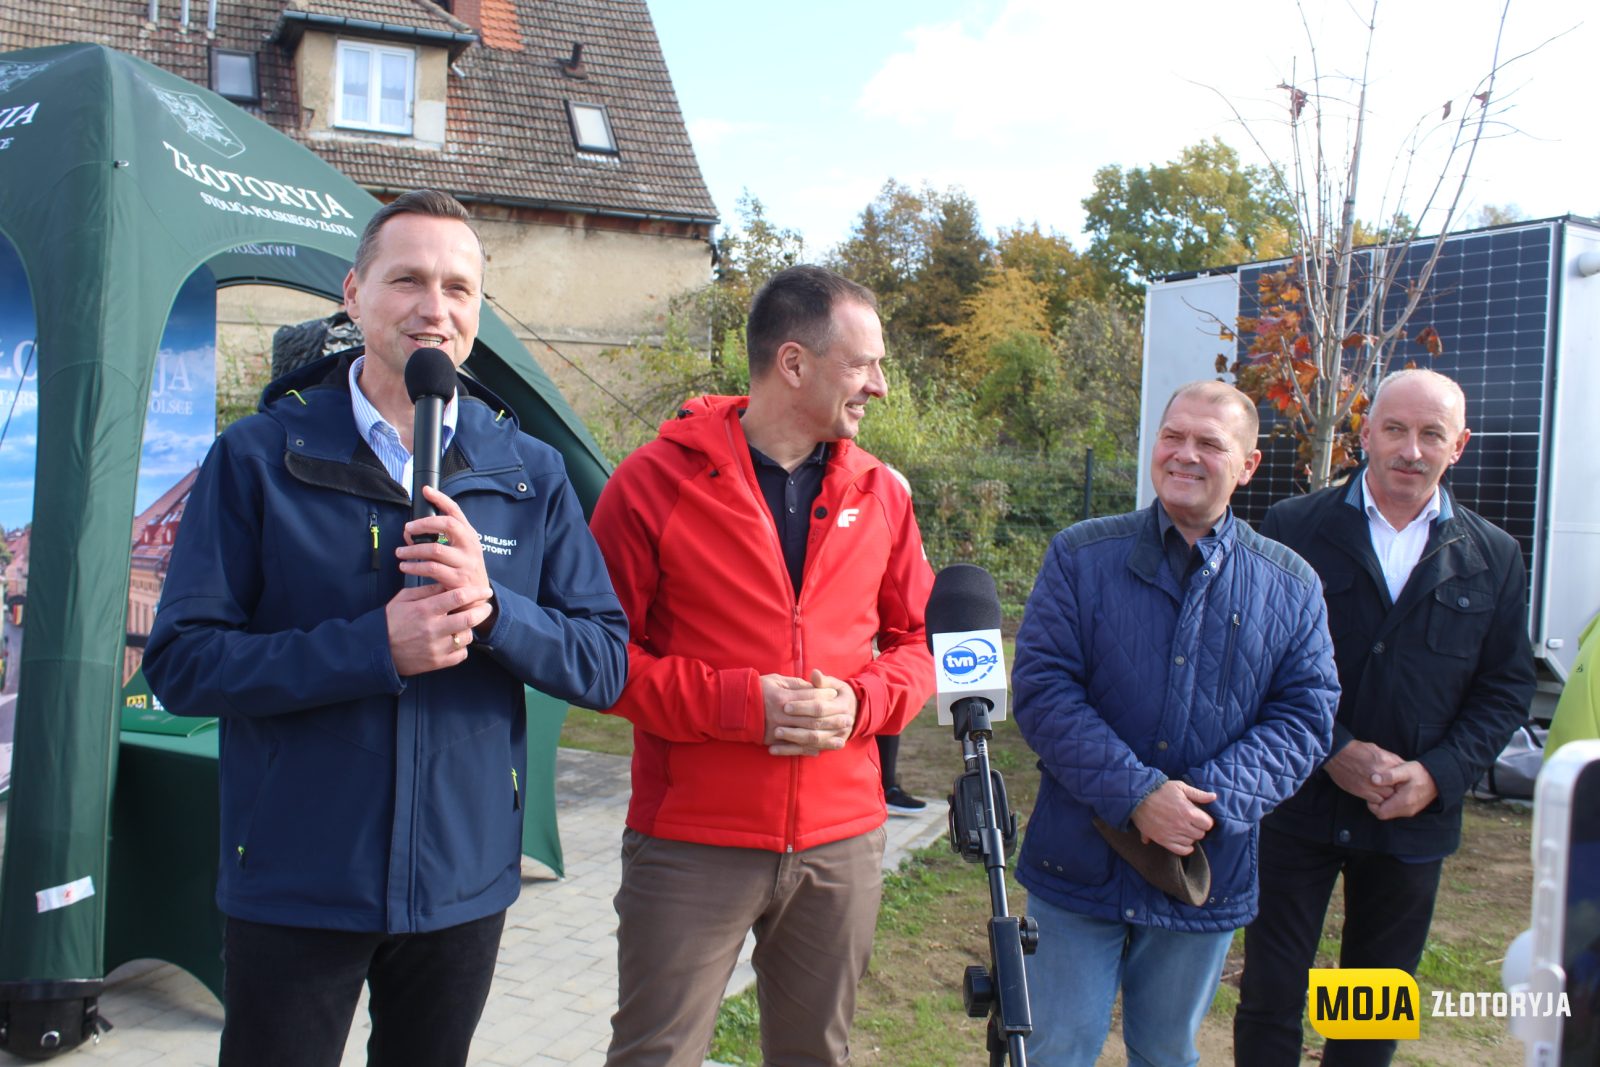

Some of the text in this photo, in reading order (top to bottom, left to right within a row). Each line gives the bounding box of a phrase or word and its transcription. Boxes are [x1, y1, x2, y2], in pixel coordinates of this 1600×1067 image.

[0, 102, 39, 129] JA
[163, 140, 354, 219] ZŁOTORYJA
[200, 192, 358, 238] STOLICA POLSKIEGO ZŁOTA
[148, 399, 193, 415] OLSCE
[484, 534, 517, 547] MIEJSKI
